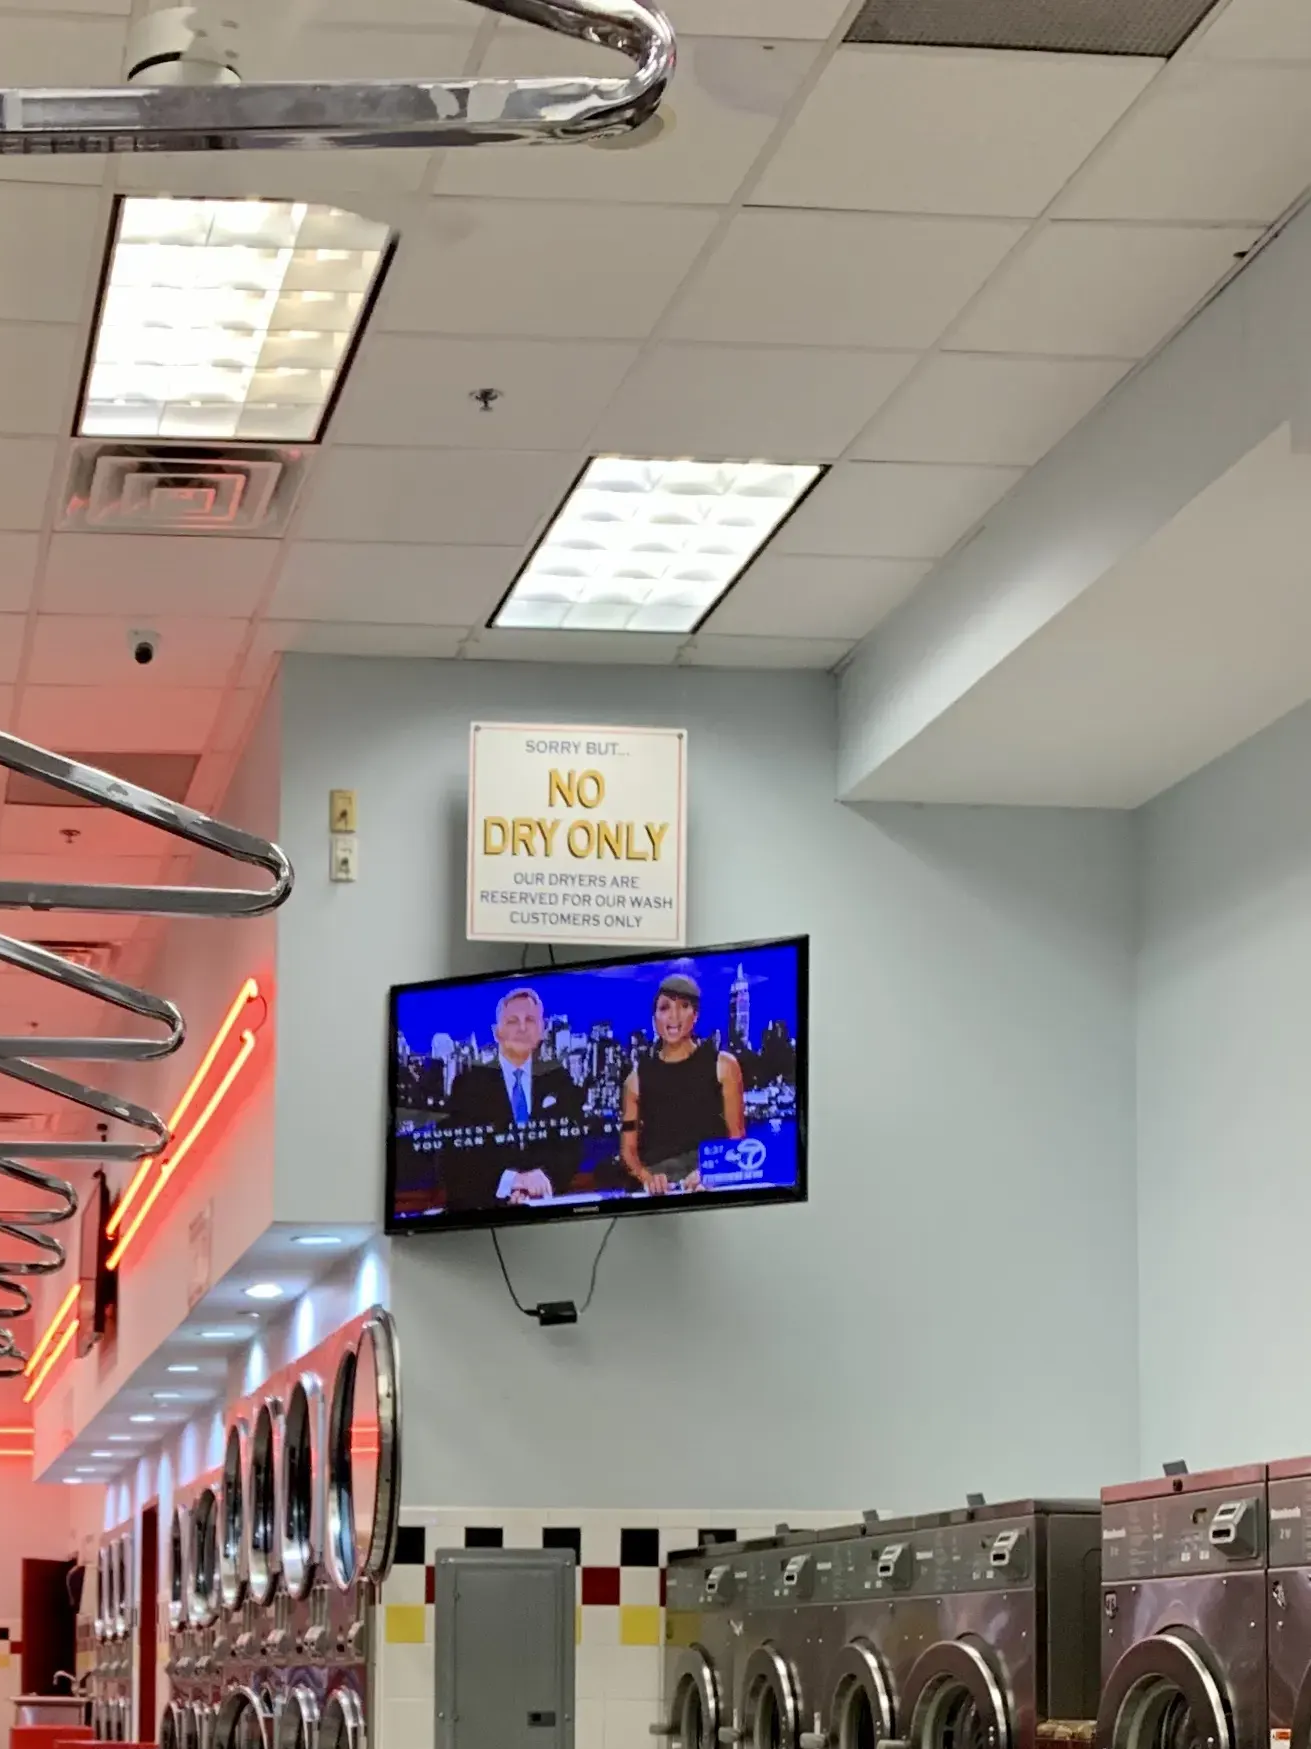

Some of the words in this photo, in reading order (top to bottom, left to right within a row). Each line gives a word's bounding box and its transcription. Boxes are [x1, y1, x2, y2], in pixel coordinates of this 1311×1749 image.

[525, 739, 581, 756] SORRY
[548, 767, 606, 809] NO
[483, 816, 562, 858] DRY
[567, 819, 669, 862] ONLY
[513, 871, 545, 886] OUR
[548, 873, 606, 889] DRYERS
[610, 875, 640, 890] ARE
[480, 889, 559, 907] RESERVED
[562, 893, 592, 908] FOR
[594, 894, 626, 909] OUR
[629, 896, 673, 910] WASH
[509, 910, 601, 928] CUSTOMERS
[604, 914, 643, 929] ONLY
[413, 1141, 443, 1152] YOU
[453, 1137, 484, 1148] CAN
[495, 1129, 547, 1144] WATCH
